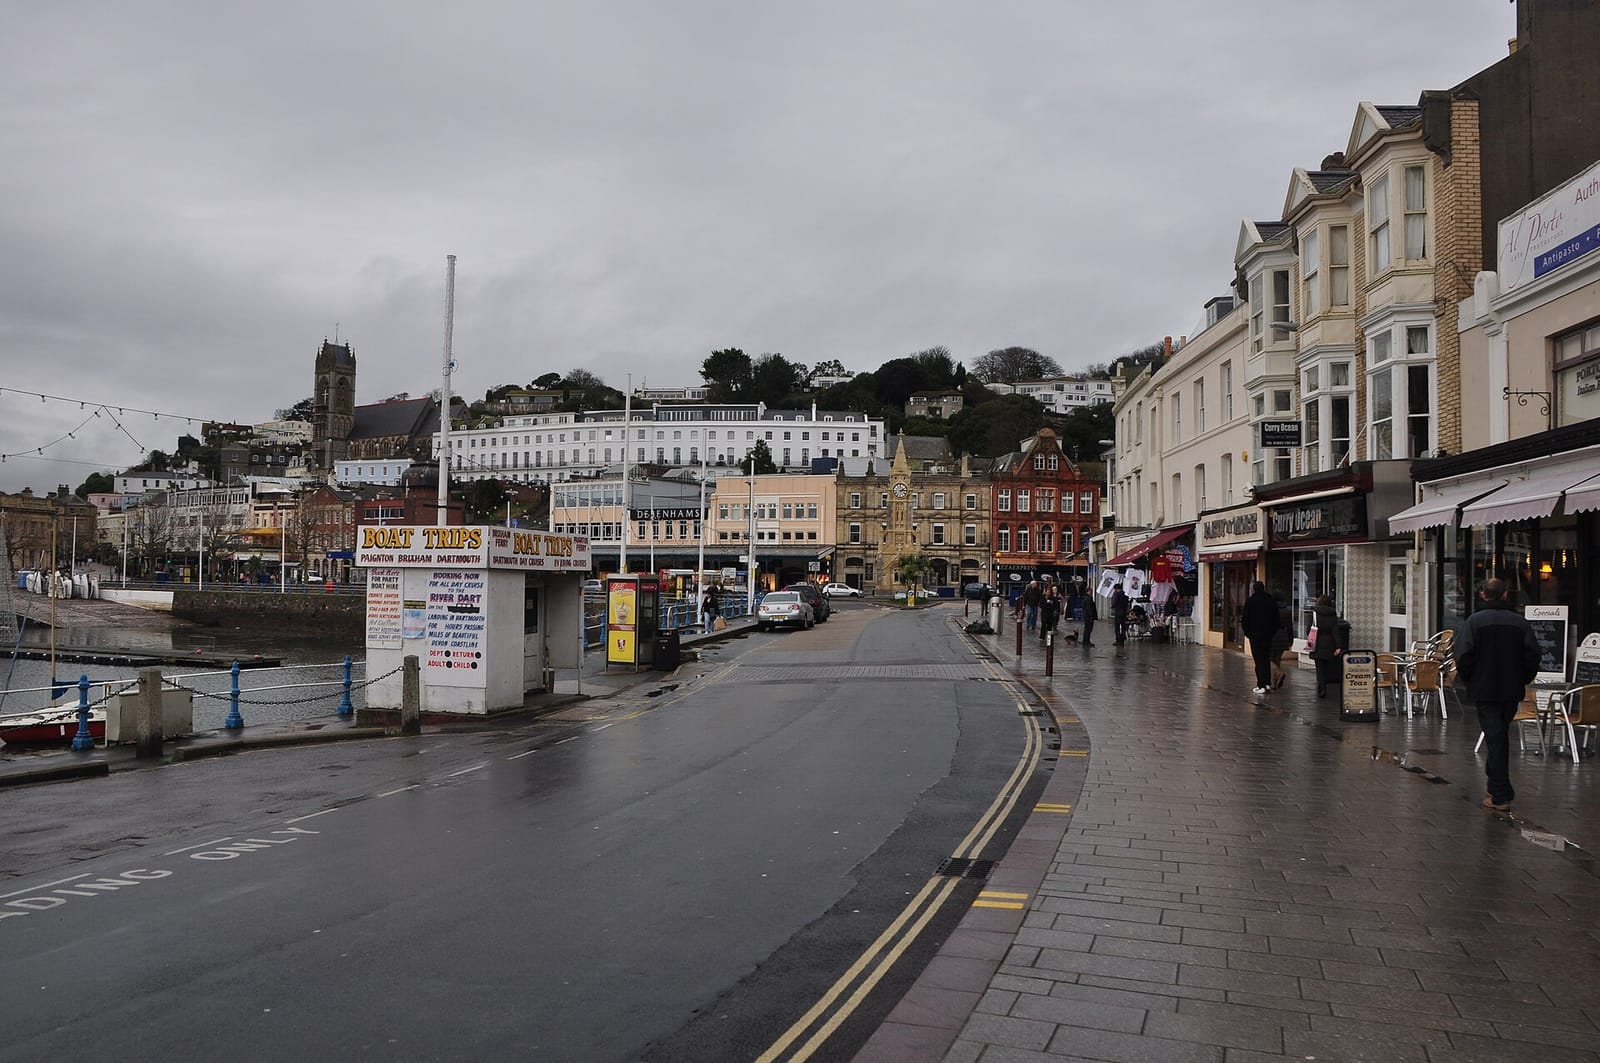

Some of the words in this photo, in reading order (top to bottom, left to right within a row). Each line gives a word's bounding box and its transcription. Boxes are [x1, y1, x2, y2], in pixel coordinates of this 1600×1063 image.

[1575, 177, 1600, 205] Auth
[1542, 241, 1581, 268] Antipasto
[1264, 423, 1280, 433] Curry
[1281, 423, 1299, 432] Ocean
[637, 509, 700, 519] DEBENHAMS
[1273, 511, 1294, 534] Curry
[1295, 508, 1322, 530] Ocean
[362, 528, 415, 549] BOAT
[423, 528, 482, 549] TRIPS
[495, 538, 508, 548] FERRY
[513, 533, 541, 555] BOAT
[544, 535, 573, 557] TRIPS
[361, 553, 394, 563] PAIGNTON
[399, 554, 432, 563] BRIXHAM
[437, 554, 481, 564] DARTMOUTH
[493, 556, 518, 566] DARTMOUTH
[519, 557, 528, 566] DAY
[528, 558, 545, 567] CRUISES
[554, 559, 572, 567] EVENING
[433, 572, 462, 580] BOOKING
[464, 573, 481, 581] NOW
[430, 593, 455, 603] RIVER
[457, 594, 482, 604] DART
[1532, 607, 1561, 618] Specials
[445, 623, 463, 631] HOURS
[452, 632, 479, 640] BEAUTIFUL
[450, 640, 479, 648] COASTLINE
[453, 661, 471, 669] CHILD
[190, 828, 320, 860] ONLY
